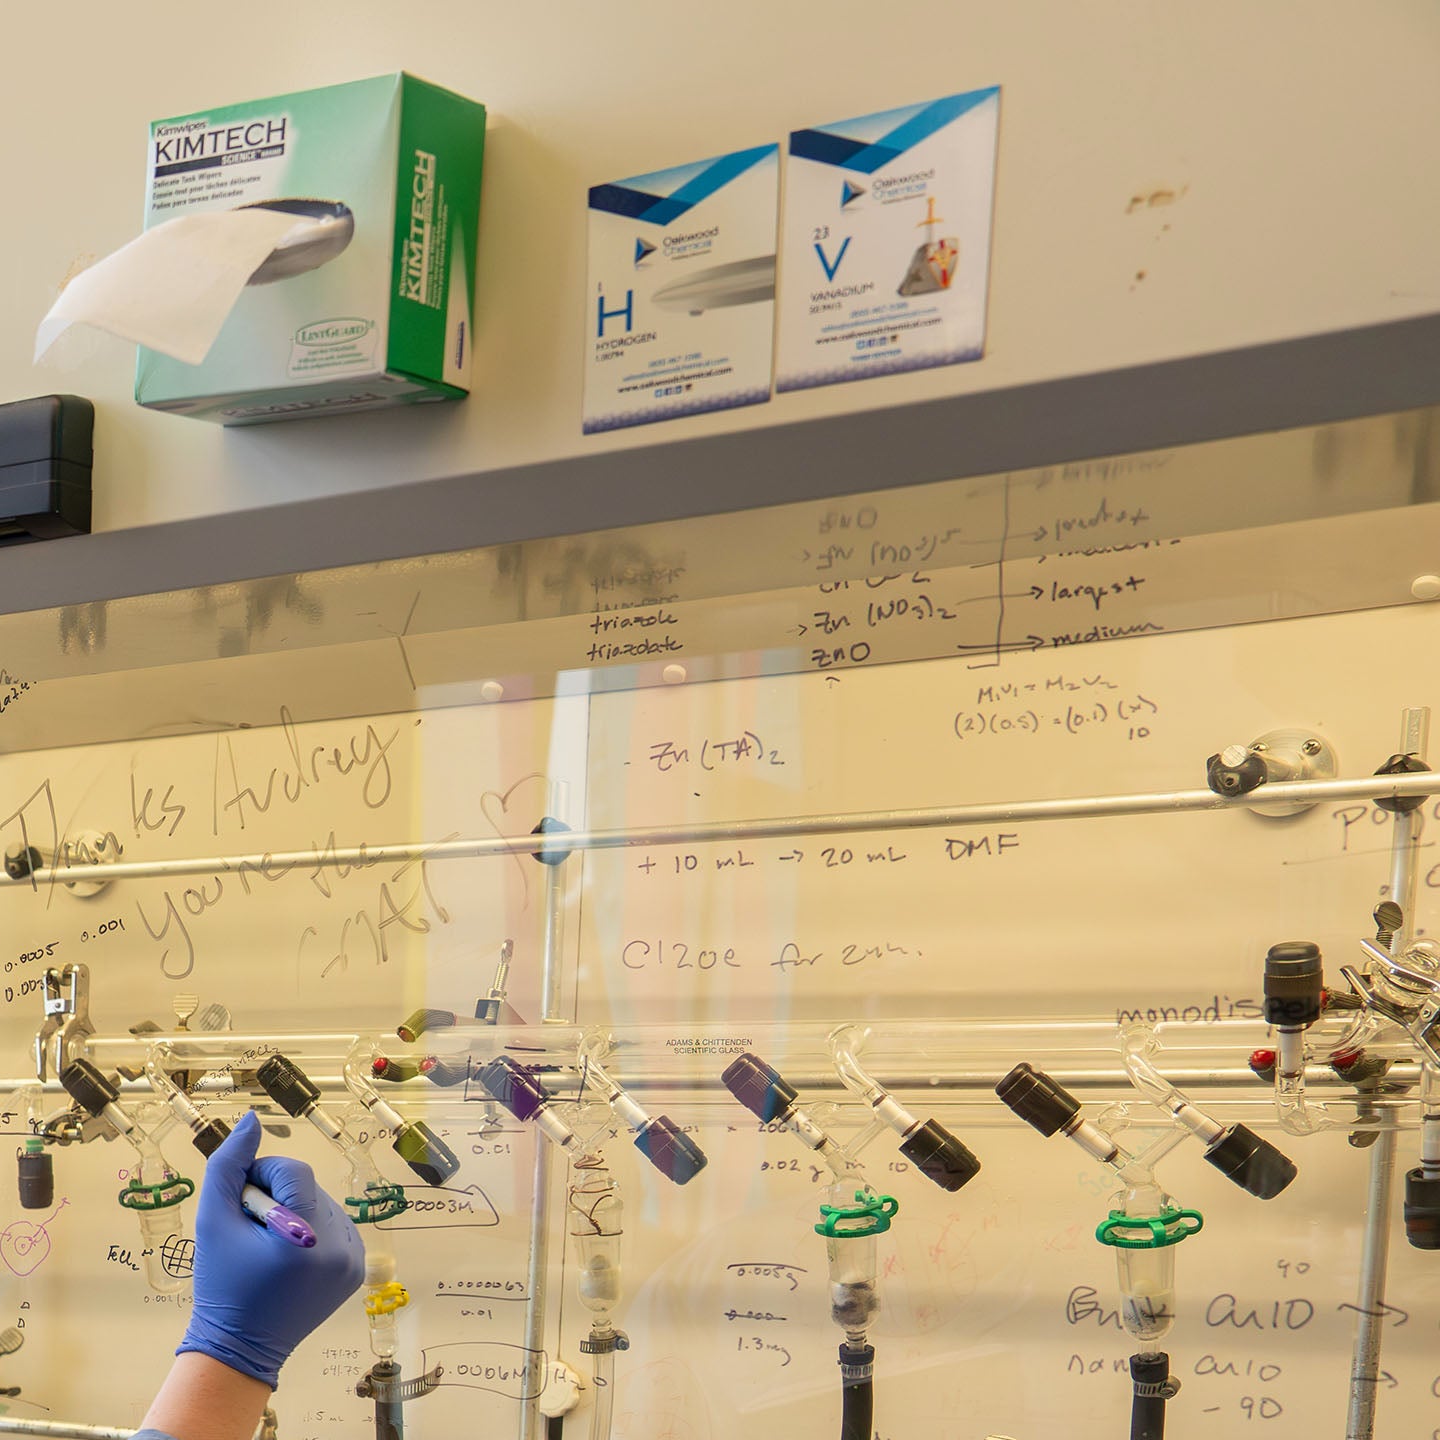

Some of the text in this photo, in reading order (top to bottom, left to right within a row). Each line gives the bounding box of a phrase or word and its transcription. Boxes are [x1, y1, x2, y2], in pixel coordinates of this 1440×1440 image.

[155, 117, 287, 164] KIMTECH
[221, 150, 256, 166] SCIENCE
[406, 149, 431, 300] KIMTECH
[663, 226, 719, 247] Oakwood
[813, 227, 830, 241] 23
[814, 235, 852, 282] V
[597, 289, 633, 337] H
[595, 332, 657, 351] HYDROGEN
[1051, 576, 1146, 610] largest
[1051, 621, 1165, 649] medium
[811, 641, 872, 668] ZnO
[674, 855, 697, 872] 10
[821, 847, 854, 869] 20
[945, 833, 1020, 861] DMF
[770, 943, 823, 972] for
[674, 1046, 745, 1054] SCIENTIFIC GLASS
[702, 1038, 753, 1046] CHITTENDEN
